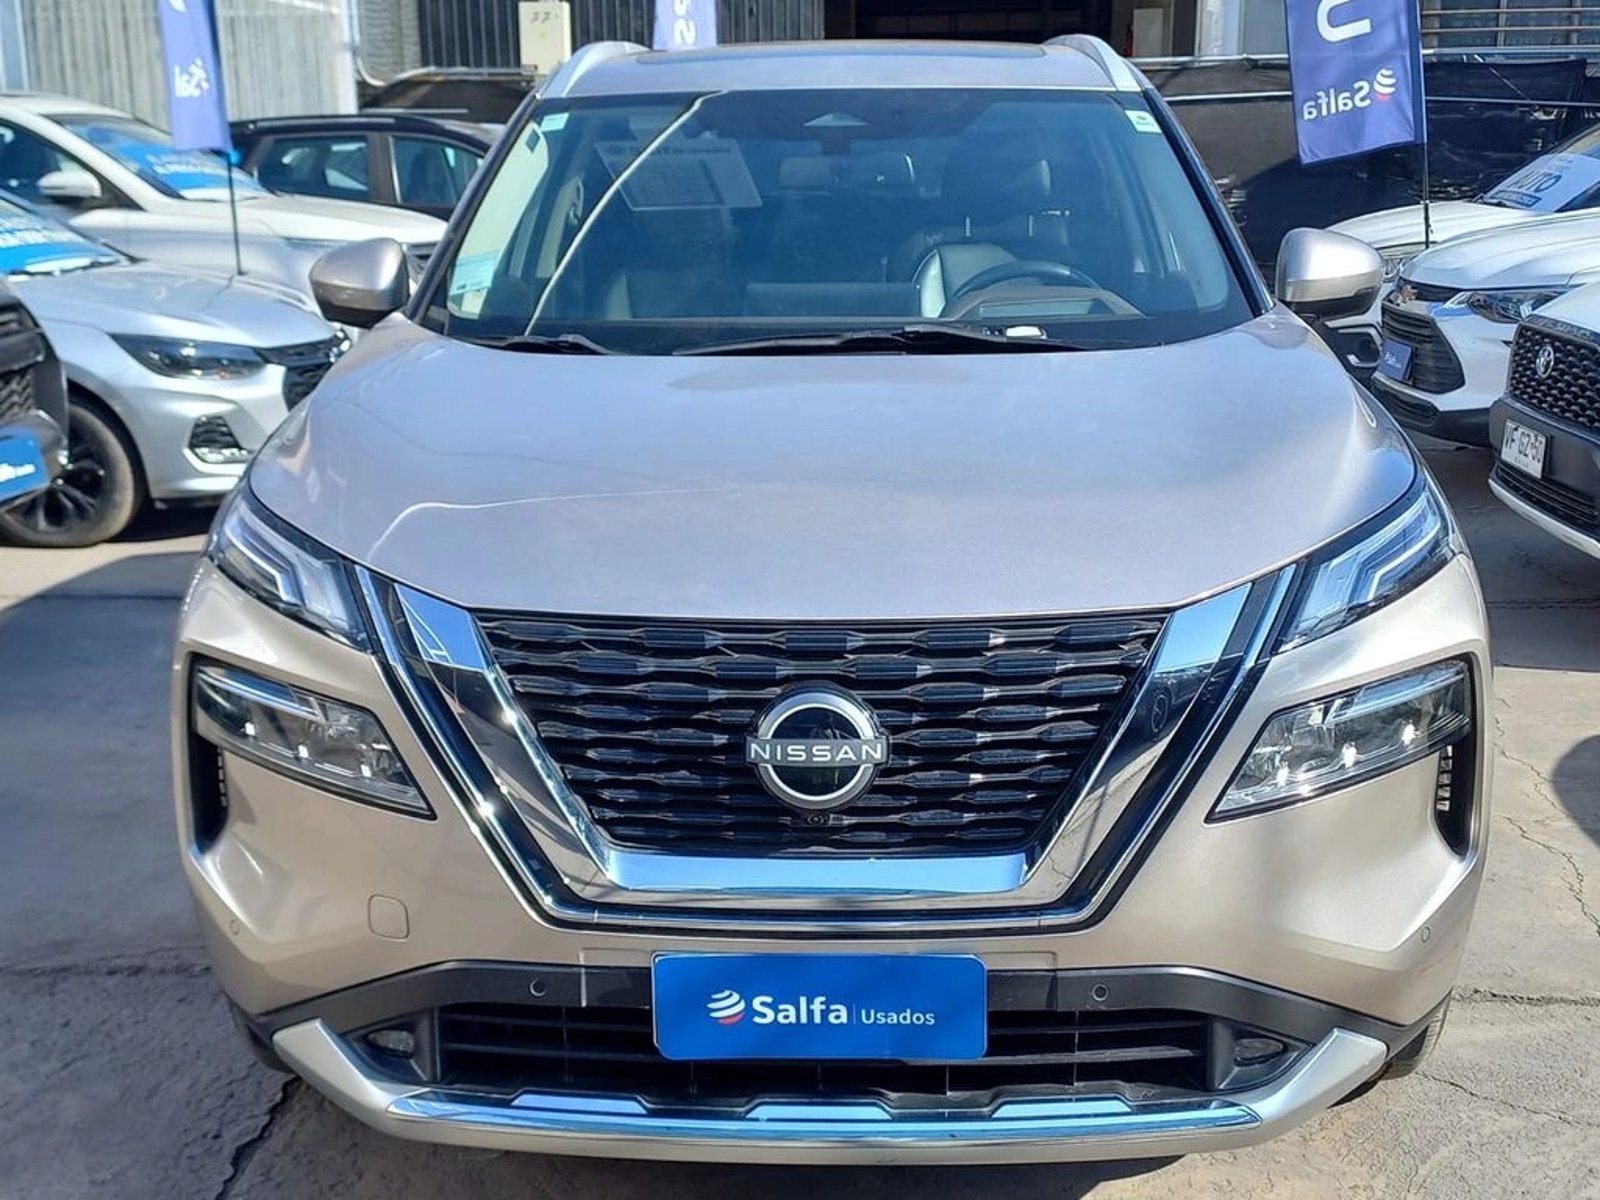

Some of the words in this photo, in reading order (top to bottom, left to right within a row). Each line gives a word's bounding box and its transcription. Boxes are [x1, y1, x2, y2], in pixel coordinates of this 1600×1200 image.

[750, 742, 882, 762] NISSAN
[752, 995, 848, 1025] Salfa
[861, 1008, 935, 1026] Usados
